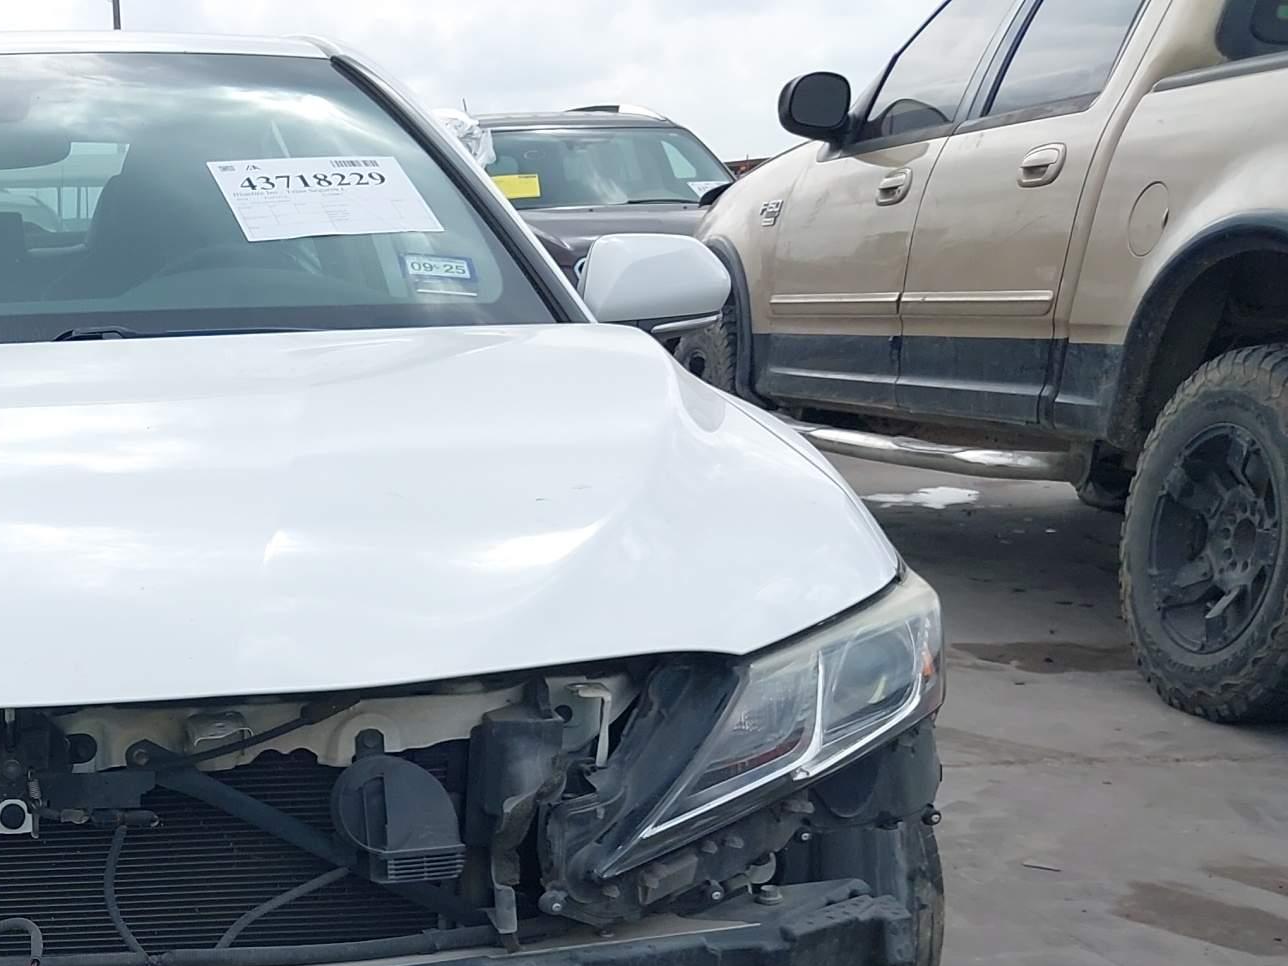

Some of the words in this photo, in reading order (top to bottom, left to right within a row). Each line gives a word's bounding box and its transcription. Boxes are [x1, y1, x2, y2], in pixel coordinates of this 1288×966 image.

[240, 171, 386, 191] 43718229
[410, 261, 433, 272] 09
[442, 263, 466, 275] 25
